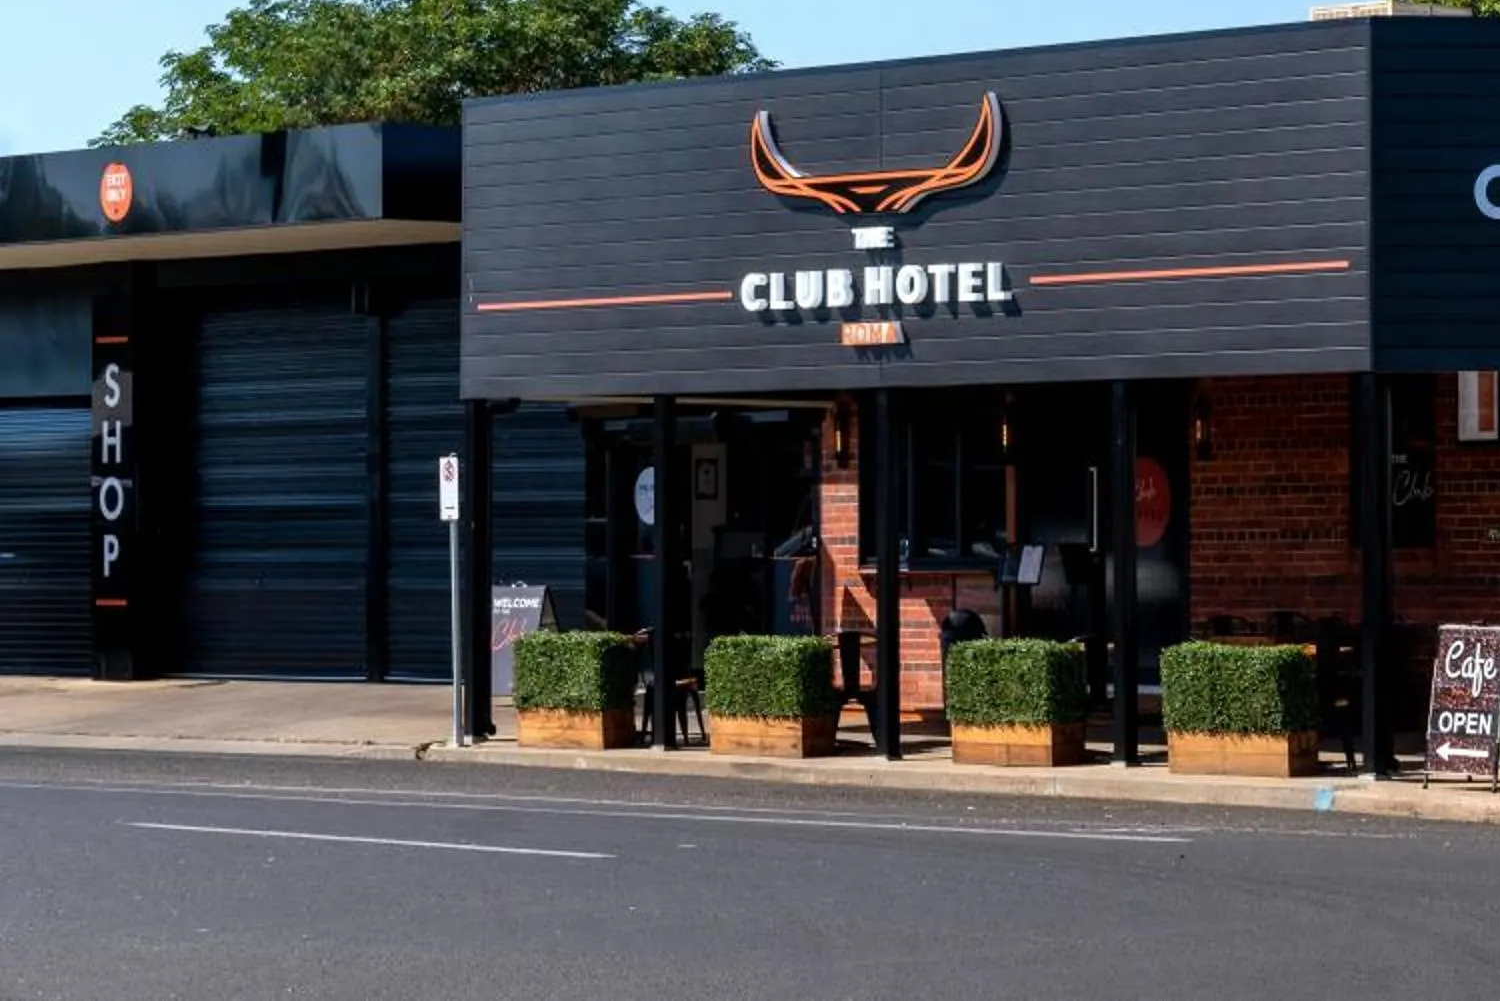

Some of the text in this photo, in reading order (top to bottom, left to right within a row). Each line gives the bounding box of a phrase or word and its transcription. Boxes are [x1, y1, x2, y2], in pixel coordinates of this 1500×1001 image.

[851, 226, 894, 249] THE
[740, 261, 1012, 311] CLUB HOTEL
[841, 321, 904, 345] ROMA
[99, 363, 124, 577] SHOP
[493, 597, 540, 608] WELCOME
[1445, 639, 1497, 698] Cafe
[1438, 711, 1493, 735] OPEN
